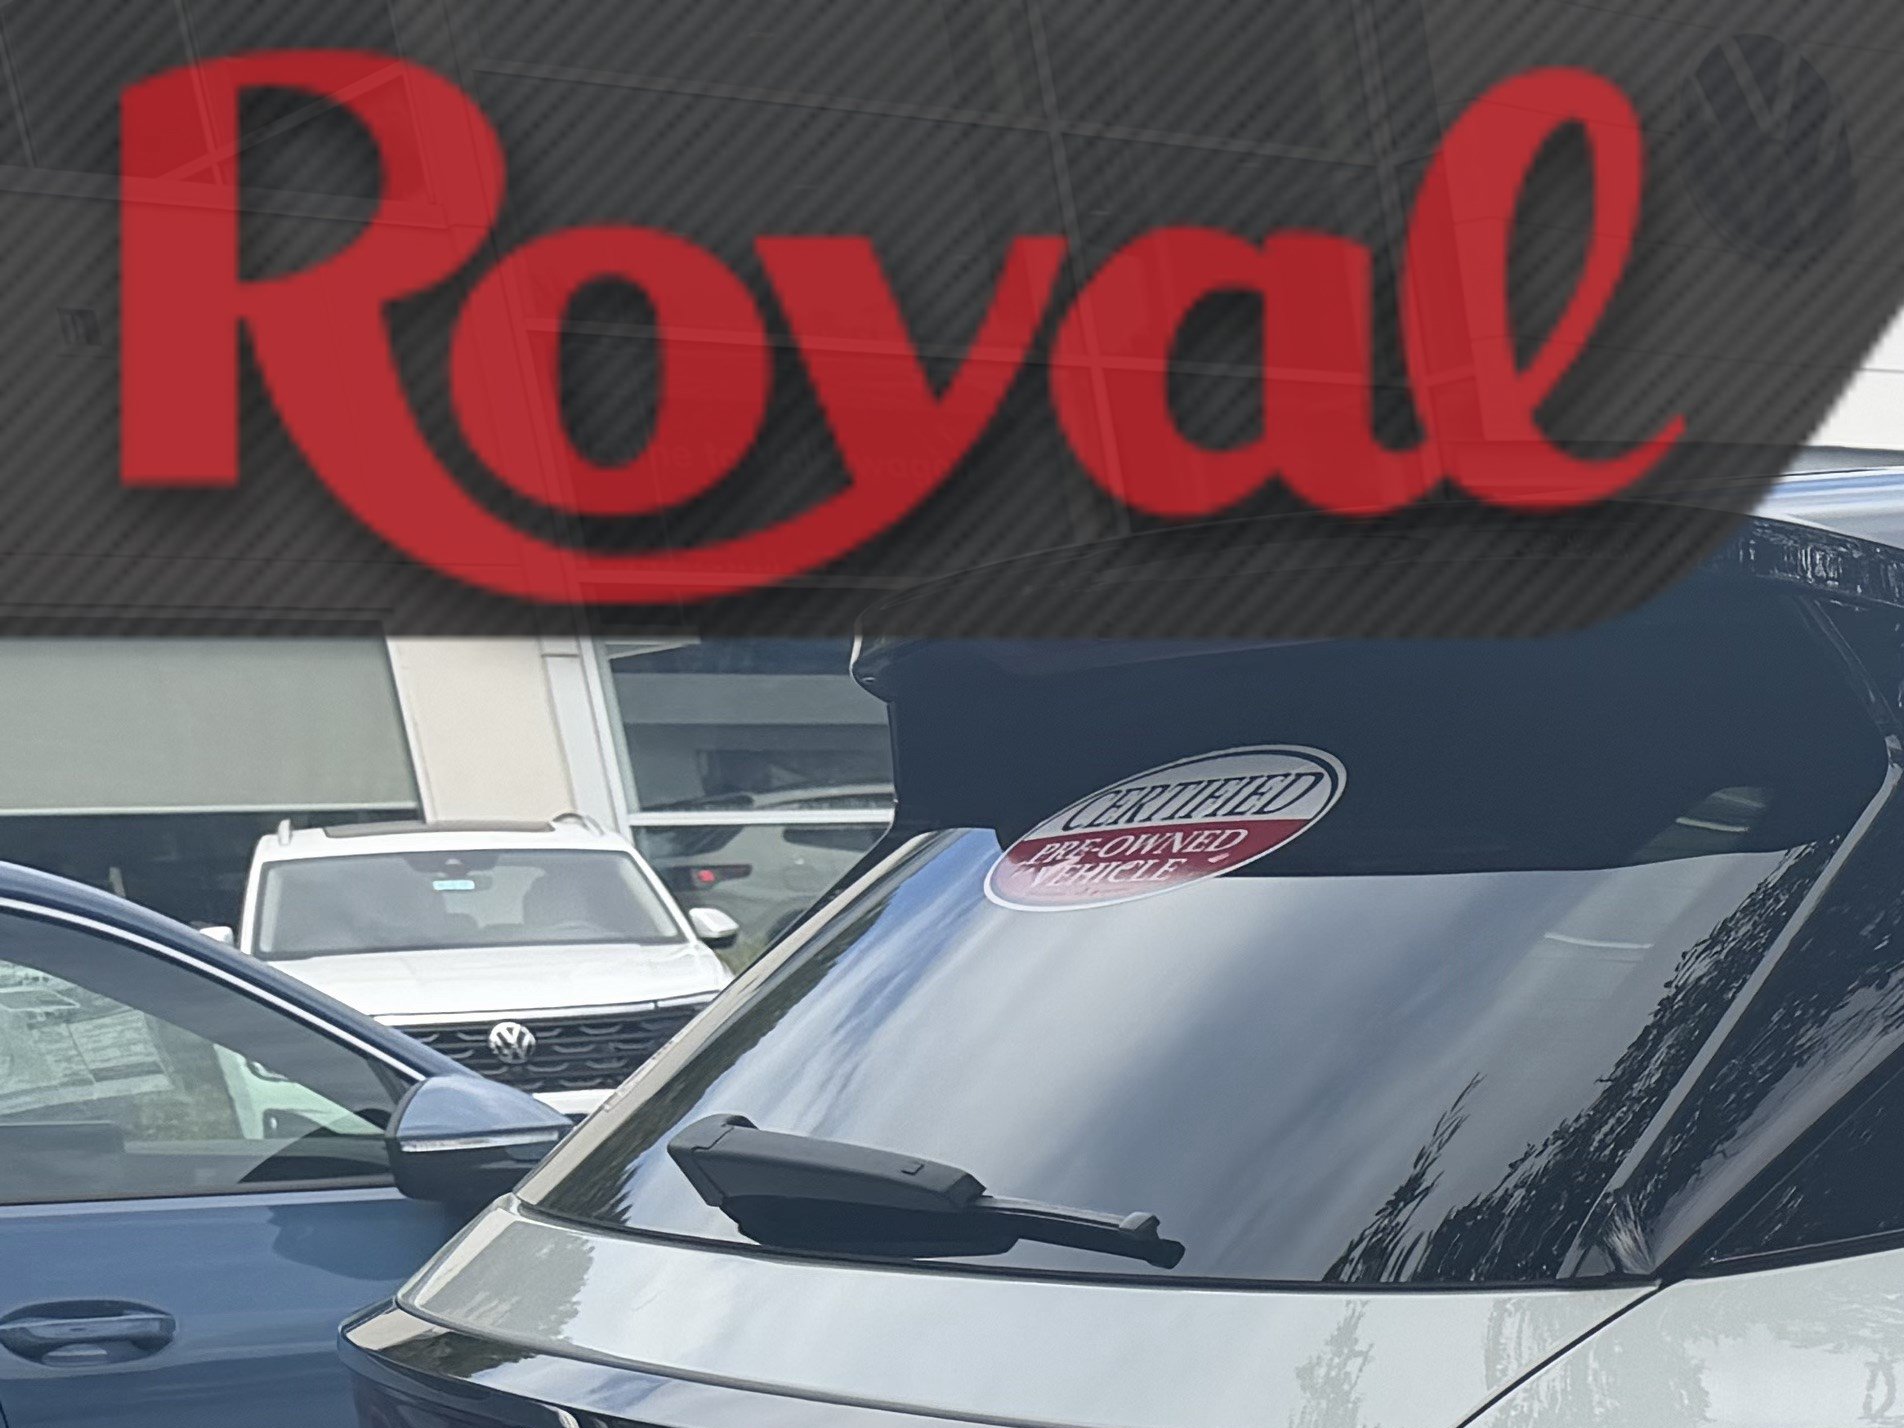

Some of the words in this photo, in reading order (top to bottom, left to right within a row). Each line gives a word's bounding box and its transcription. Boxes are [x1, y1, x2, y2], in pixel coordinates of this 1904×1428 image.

[1062, 771, 1325, 833] CERTIFIED
[1027, 828, 1249, 866] PRE-OWNED
[1030, 857, 1188, 889] VEHICLE
